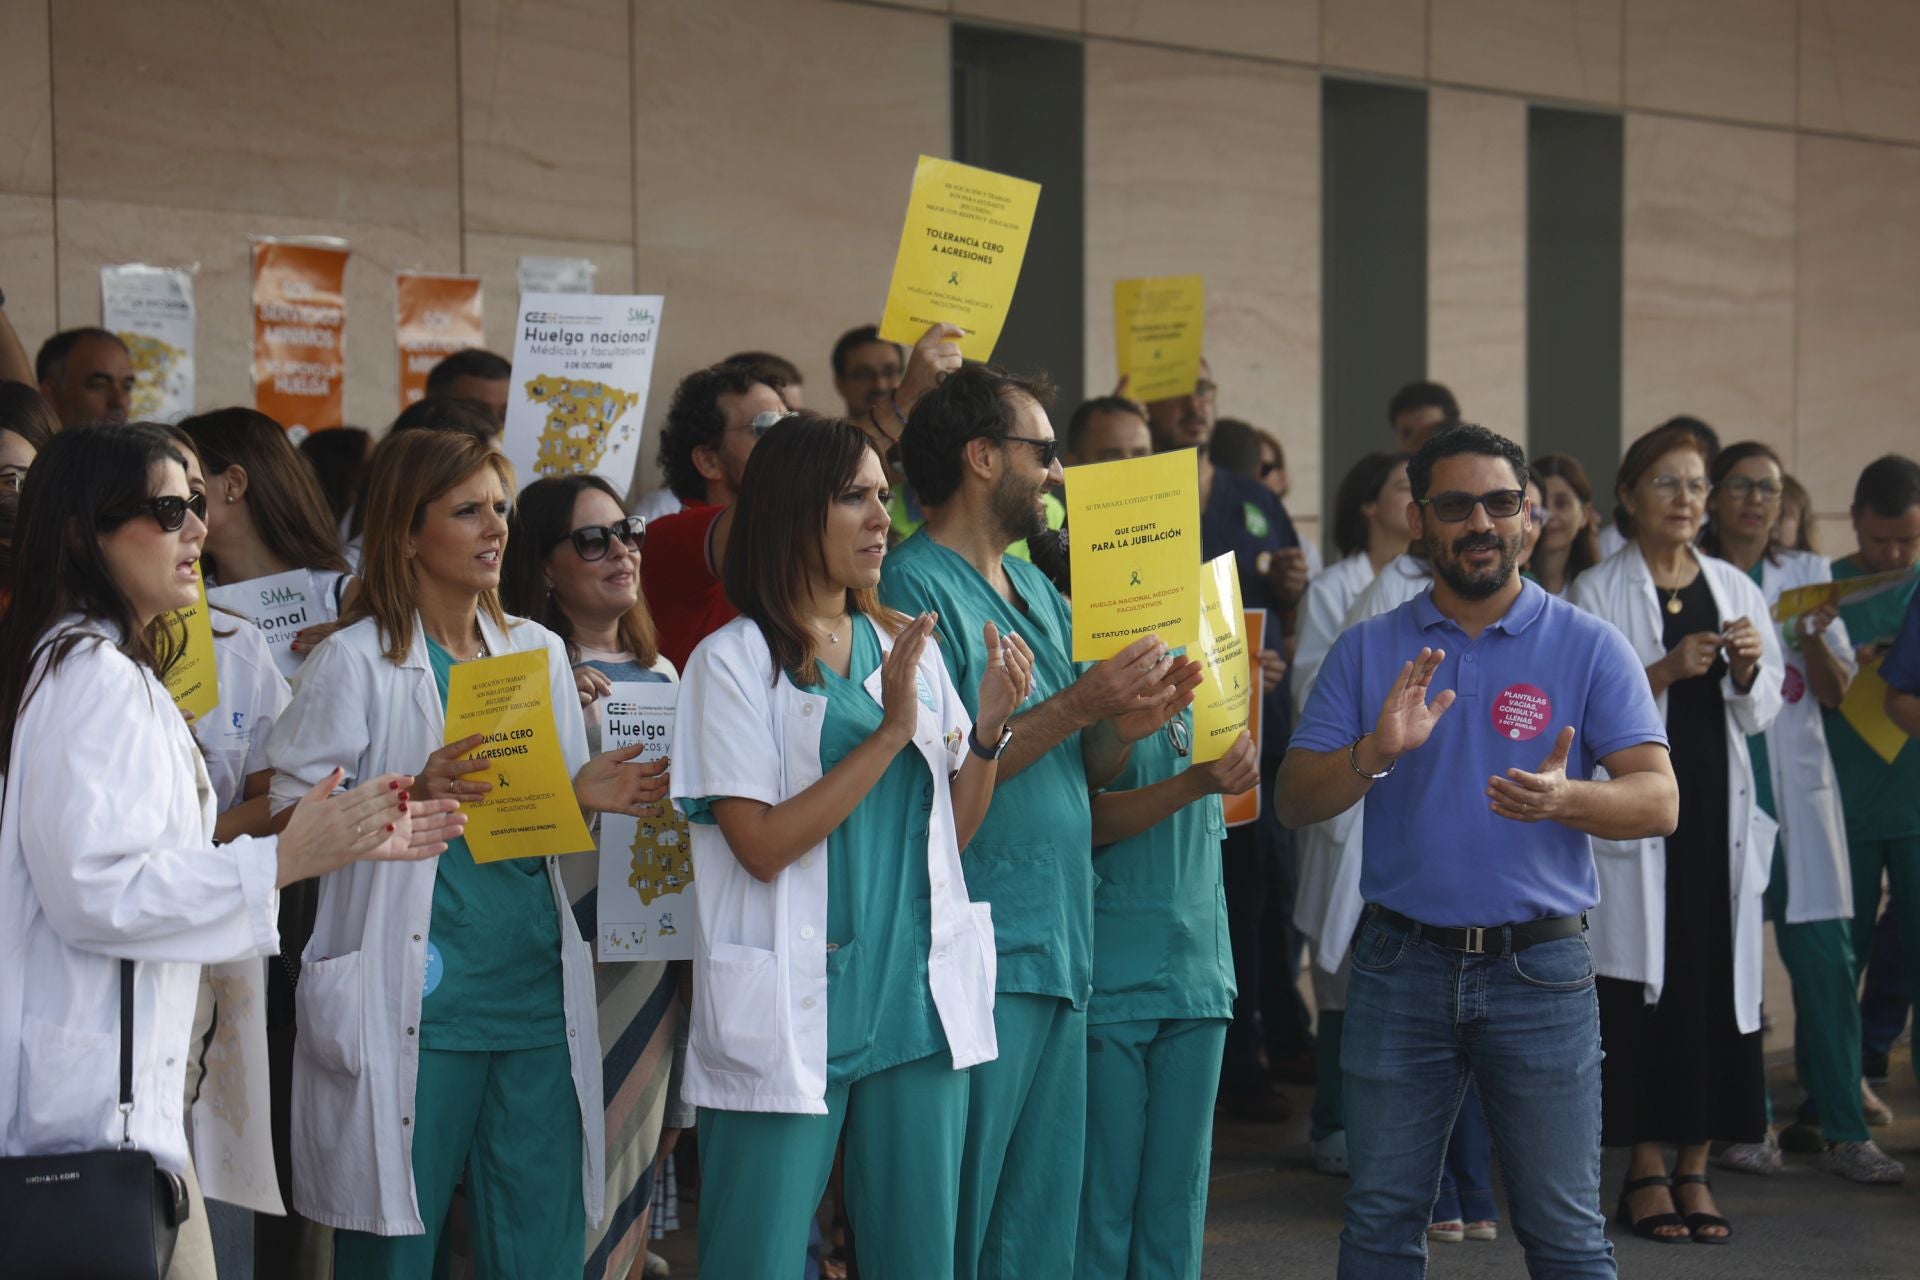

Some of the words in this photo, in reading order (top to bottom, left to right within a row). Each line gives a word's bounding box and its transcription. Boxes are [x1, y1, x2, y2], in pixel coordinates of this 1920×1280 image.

[926, 228, 979, 247] TOLERANCIA
[982, 242, 1004, 253] CERO
[932, 244, 938, 252] A
[941, 245, 993, 264] AGRESIONES
[525, 327, 583, 346] Huelga
[590, 328, 651, 343] nacional
[530, 344, 577, 355] Médicos
[579, 347, 586, 357] y
[591, 345, 646, 356] facultativos
[1155, 490, 1180, 499] TRIBUTO
[1131, 523, 1156, 532] CUENTE
[1092, 541, 1115, 552] PARA
[1131, 528, 1181, 546] JUBILACIÓN
[260, 586, 301, 605] SMA
[1090, 599, 1118, 608] HUELGA
[1119, 594, 1151, 604] NACIONAL
[1117, 601, 1162, 613] FACULTATIVOS
[255, 607, 307, 630] ional
[1092, 630, 1130, 639] ESTATUTO
[1132, 625, 1157, 634] MARCO
[1158, 618, 1182, 628] PROPIO
[181, 681, 202, 700] PROPIO
[1504, 691, 1546, 705] PLANTILLAS
[1500, 706, 1543, 720] CONSULTAS
[1506, 714, 1532, 724] LLENAS
[610, 720, 665, 740] Huelga
[1210, 723, 1238, 737] ESTATUTO
[1515, 722, 1536, 731] HUELGA
[510, 729, 533, 740] CERO
[476, 745, 528, 760] AGRESIONES
[665, 743, 671, 754] y
[470, 799, 495, 808] HUELGA
[496, 796, 524, 804] NACIONAL
[497, 804, 536, 813] FACULTATIVOS
[490, 828, 517, 836] ESTATUTO
[517, 825, 536, 833] MARCO
